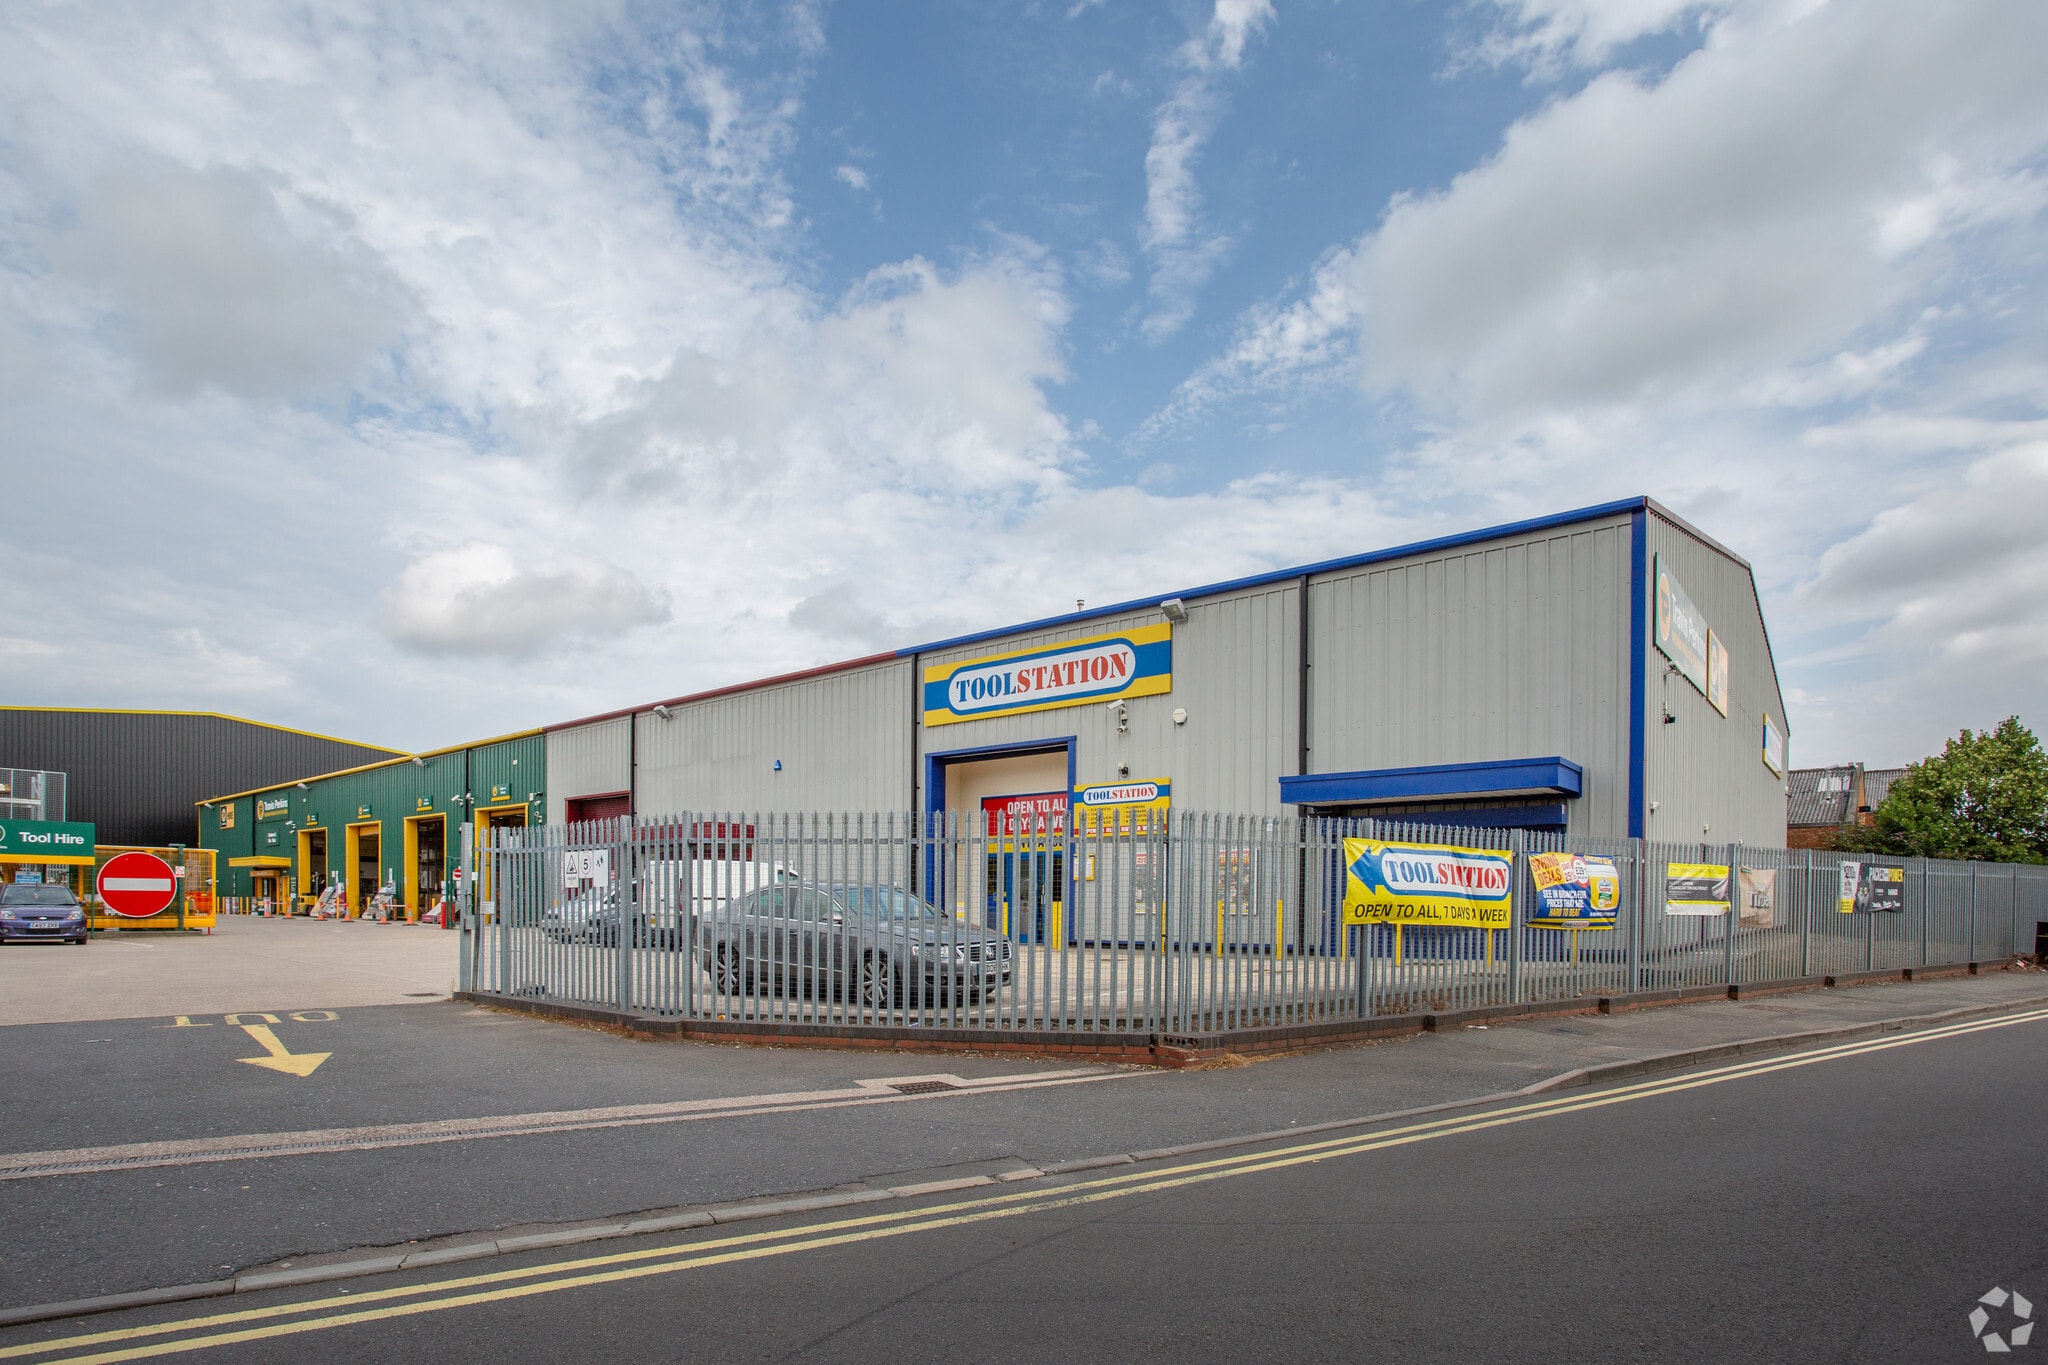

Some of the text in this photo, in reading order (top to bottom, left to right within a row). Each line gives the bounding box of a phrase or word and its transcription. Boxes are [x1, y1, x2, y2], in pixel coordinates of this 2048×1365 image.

[1671, 592, 1688, 639] Travis
[956, 651, 1128, 703] TOOLSTATION
[1086, 786, 1155, 801] TOOLSTATION
[1007, 800, 1034, 815] OPEN
[1036, 799, 1049, 812] TO
[19, 831, 85, 845] Tool Hire
[584, 858, 588, 870] 5
[1530, 854, 1562, 886] SPRING DEALS
[1384, 860, 1507, 890] TOOLSTATION
[1542, 890, 1552, 898] SEE
[1546, 899, 1563, 908] PRICES
[1354, 904, 1508, 922] OPEN TO ALL, 7 DAYS A WEEK
[152, 1010, 341, 1028] OUT
